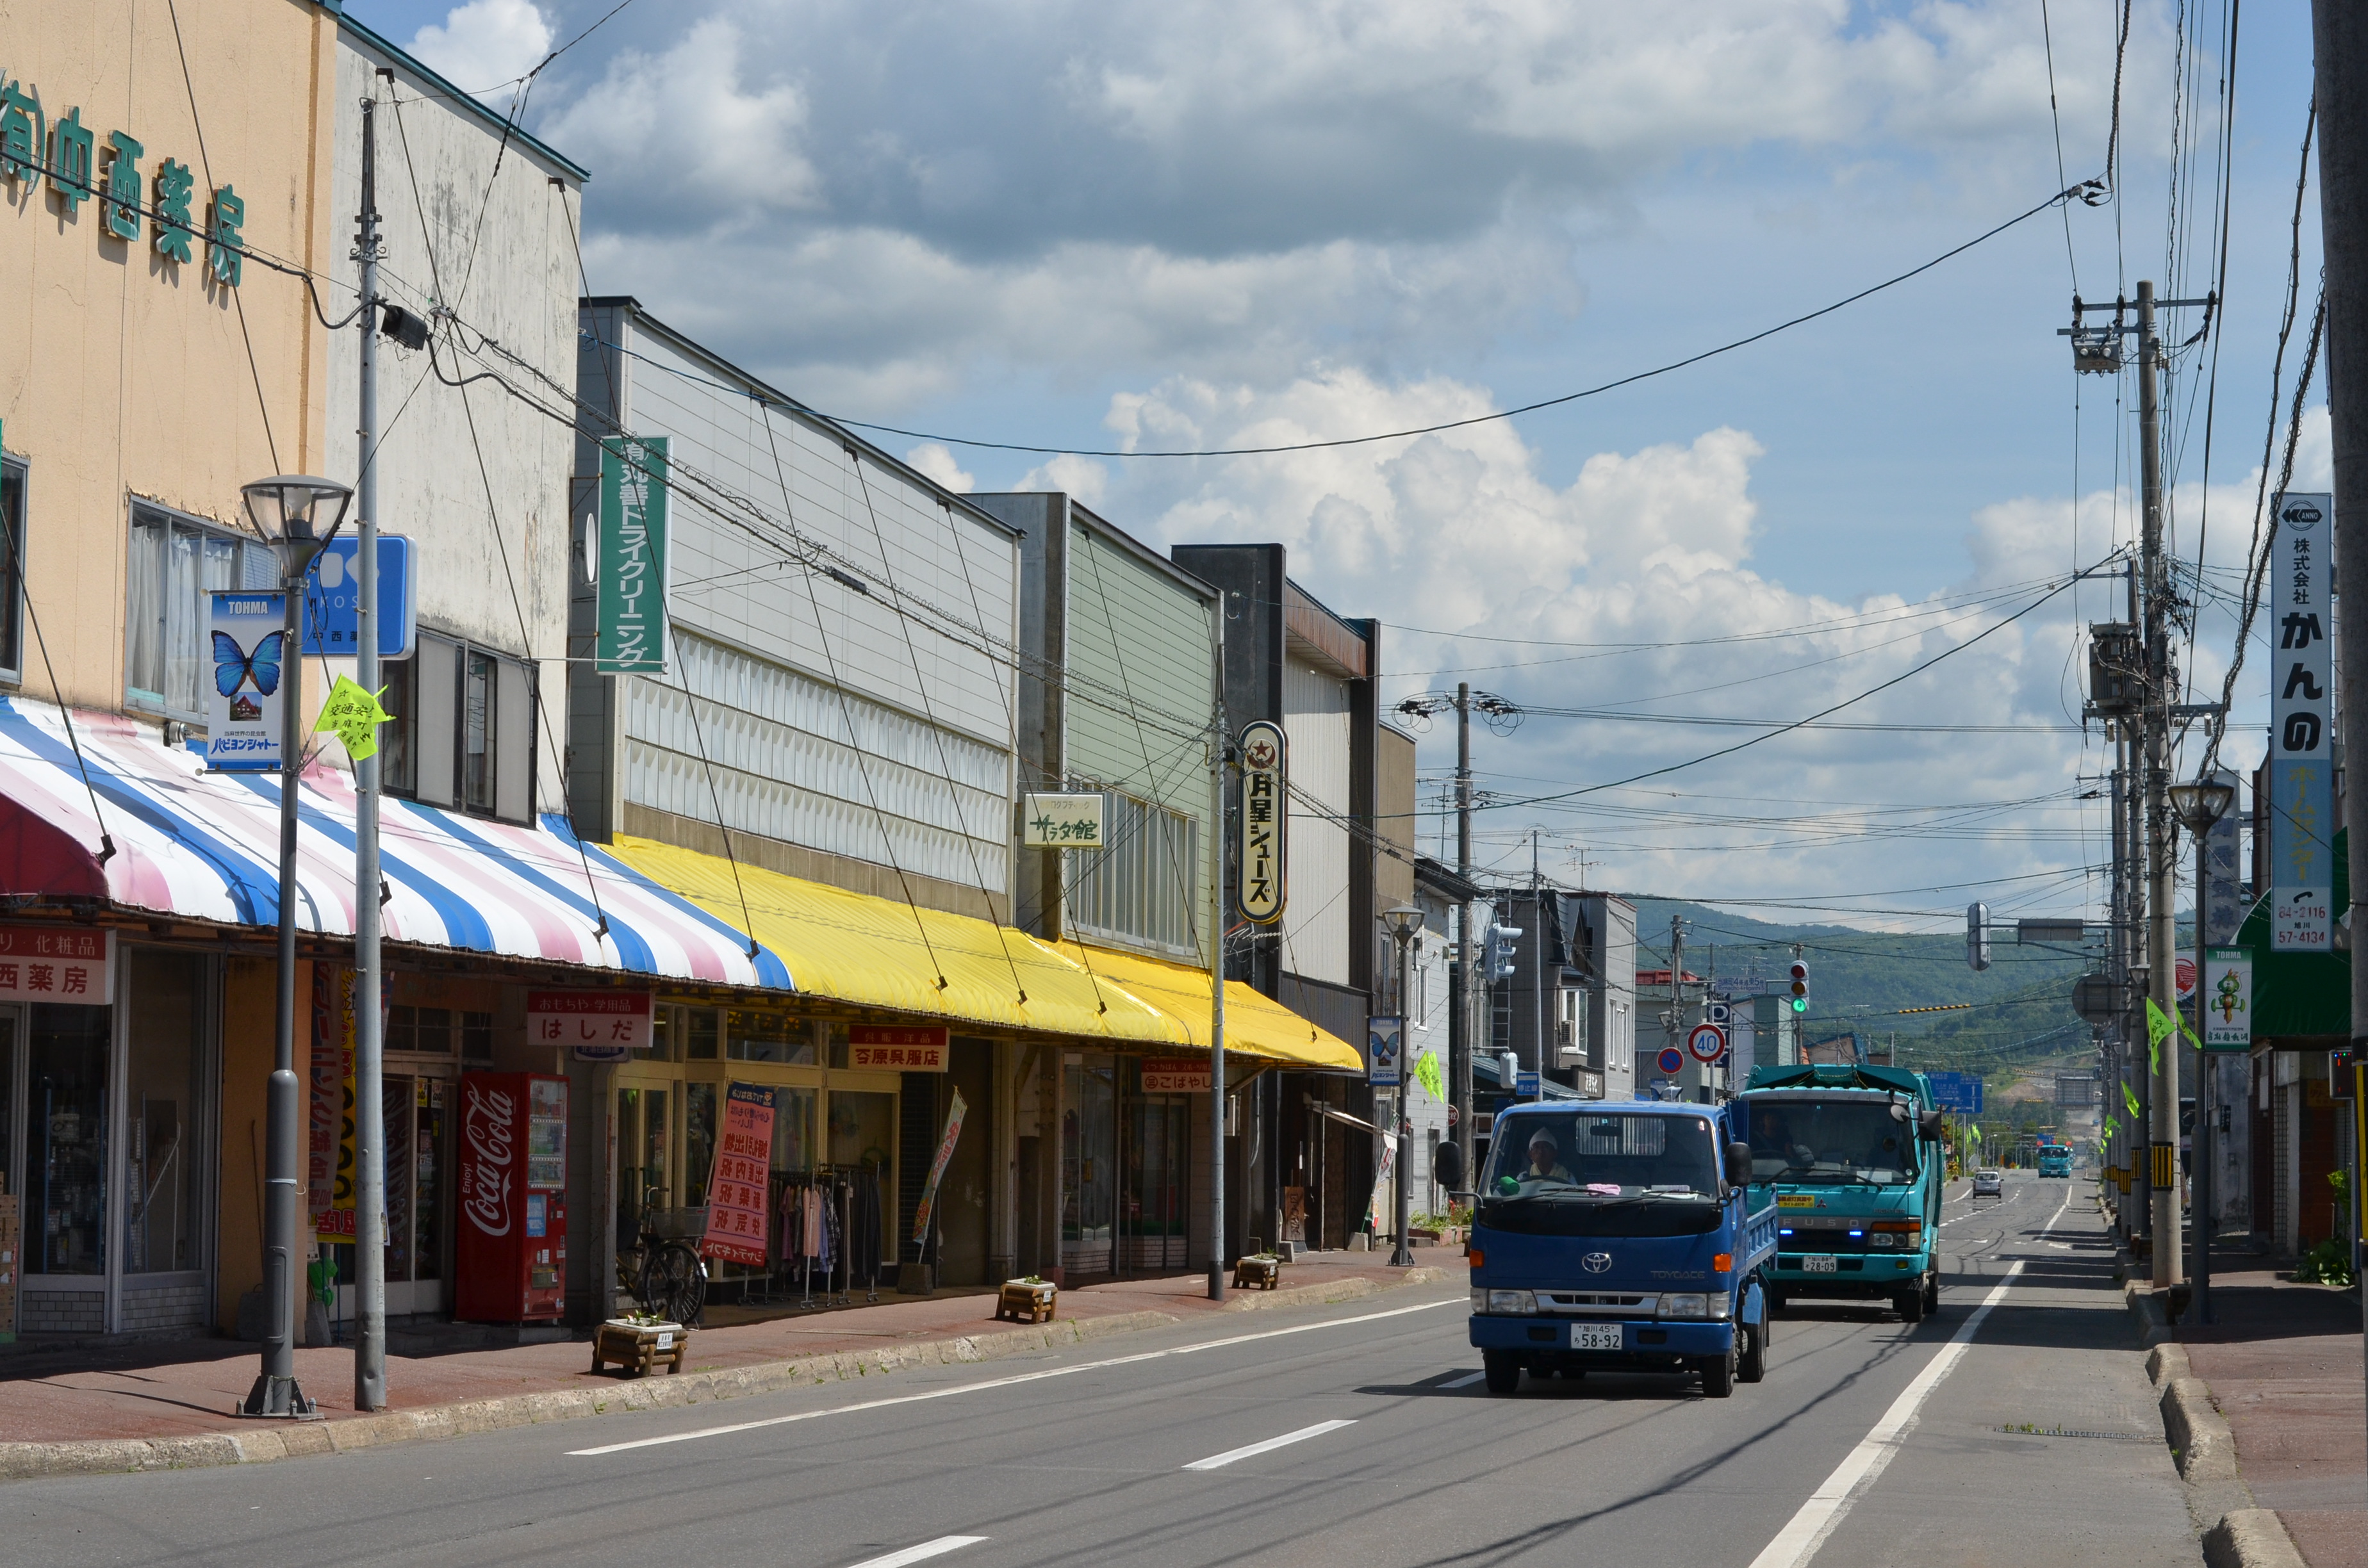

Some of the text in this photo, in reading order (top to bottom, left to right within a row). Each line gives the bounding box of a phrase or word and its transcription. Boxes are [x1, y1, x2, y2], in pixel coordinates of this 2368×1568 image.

[2293, 538, 2310, 605] 株式会社
[228, 601, 268, 615] TOHMA
[2280, 612, 2323, 752] かんの
[211, 738, 279, 755] パピヨンシャトー
[1029, 814, 1098, 842] サラダ館
[2289, 766, 2316, 881] ホームセンター
[1249, 773, 1272, 903] 月星シューズ
[2278, 931, 2325, 943] 57-4134
[1697, 1034, 1717, 1051] 40
[465, 1081, 513, 1236] Coca-Cola
[463, 1163, 473, 1194] Enjoy!
[1650, 1271, 1705, 1279] TOYOACE
[1811, 1262, 1835, 1271] 28-09
[1582, 1334, 1620, 1348] 58-92
